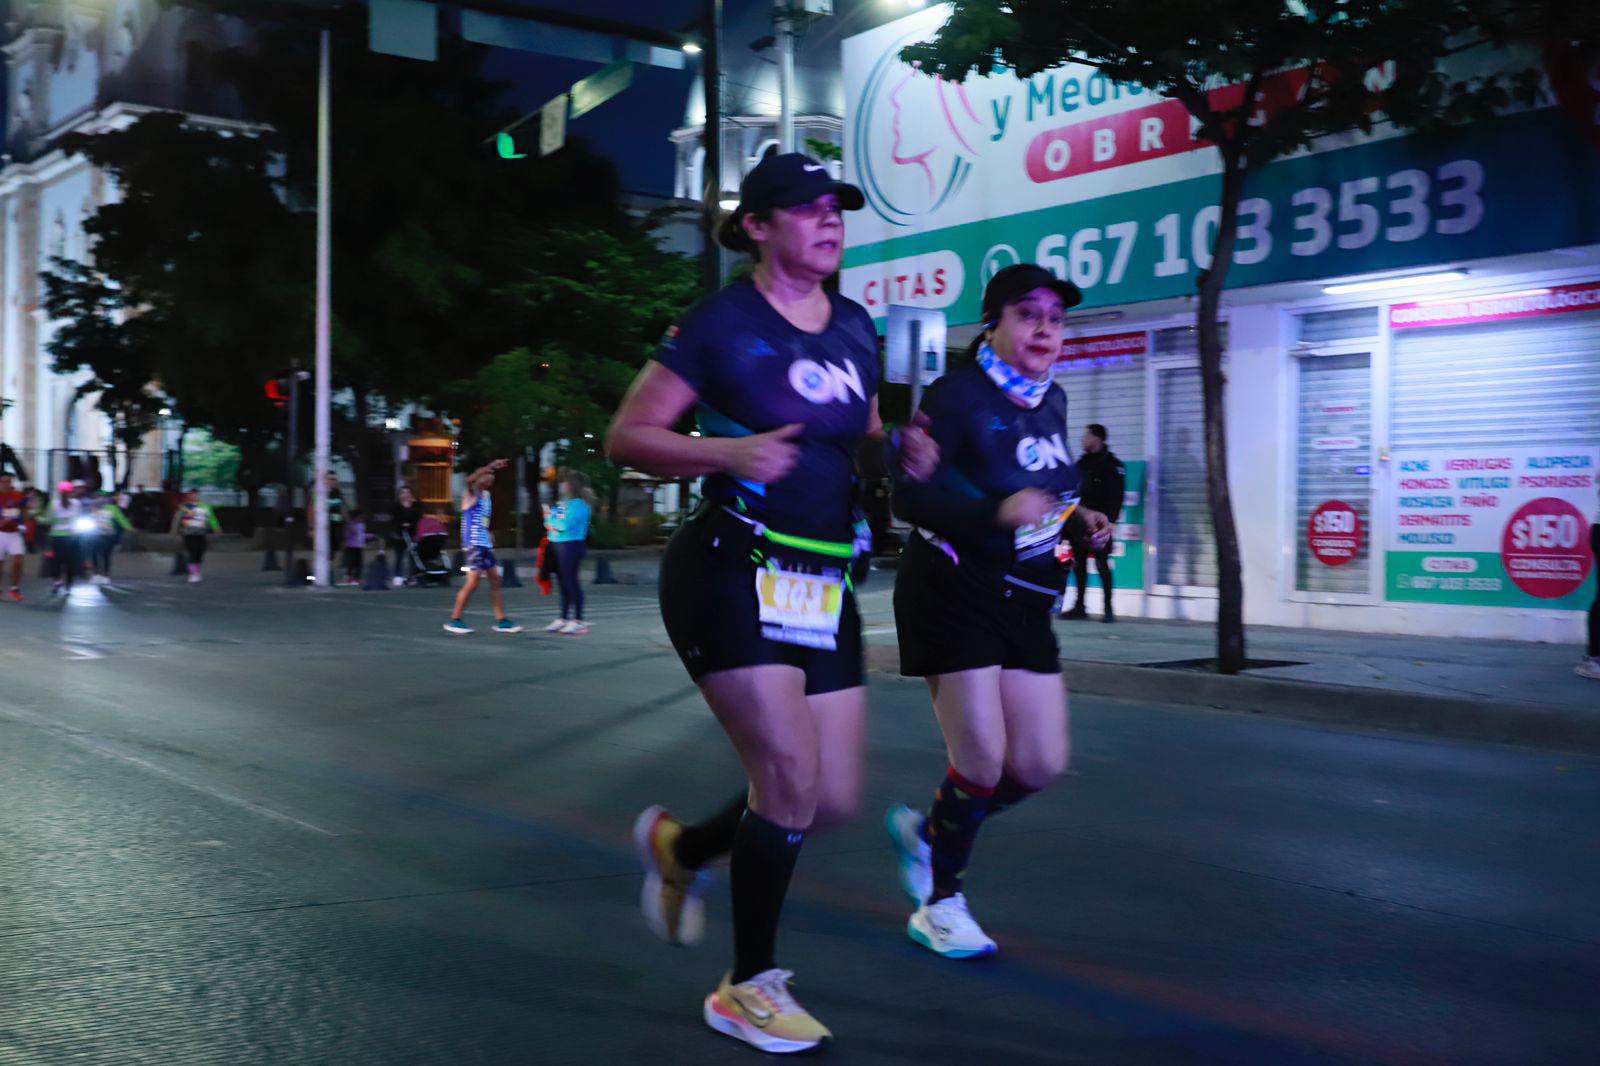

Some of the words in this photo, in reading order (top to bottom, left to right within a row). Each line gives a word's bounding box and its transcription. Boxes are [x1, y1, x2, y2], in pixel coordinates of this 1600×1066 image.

[989, 95, 1011, 141] y
[863, 267, 946, 306] CITAS
[1036, 220, 1138, 290] 667
[1290, 159, 1486, 257] 3533
[788, 357, 866, 405] ON
[1016, 432, 1074, 472] ON
[1511, 514, 1580, 549] $150
